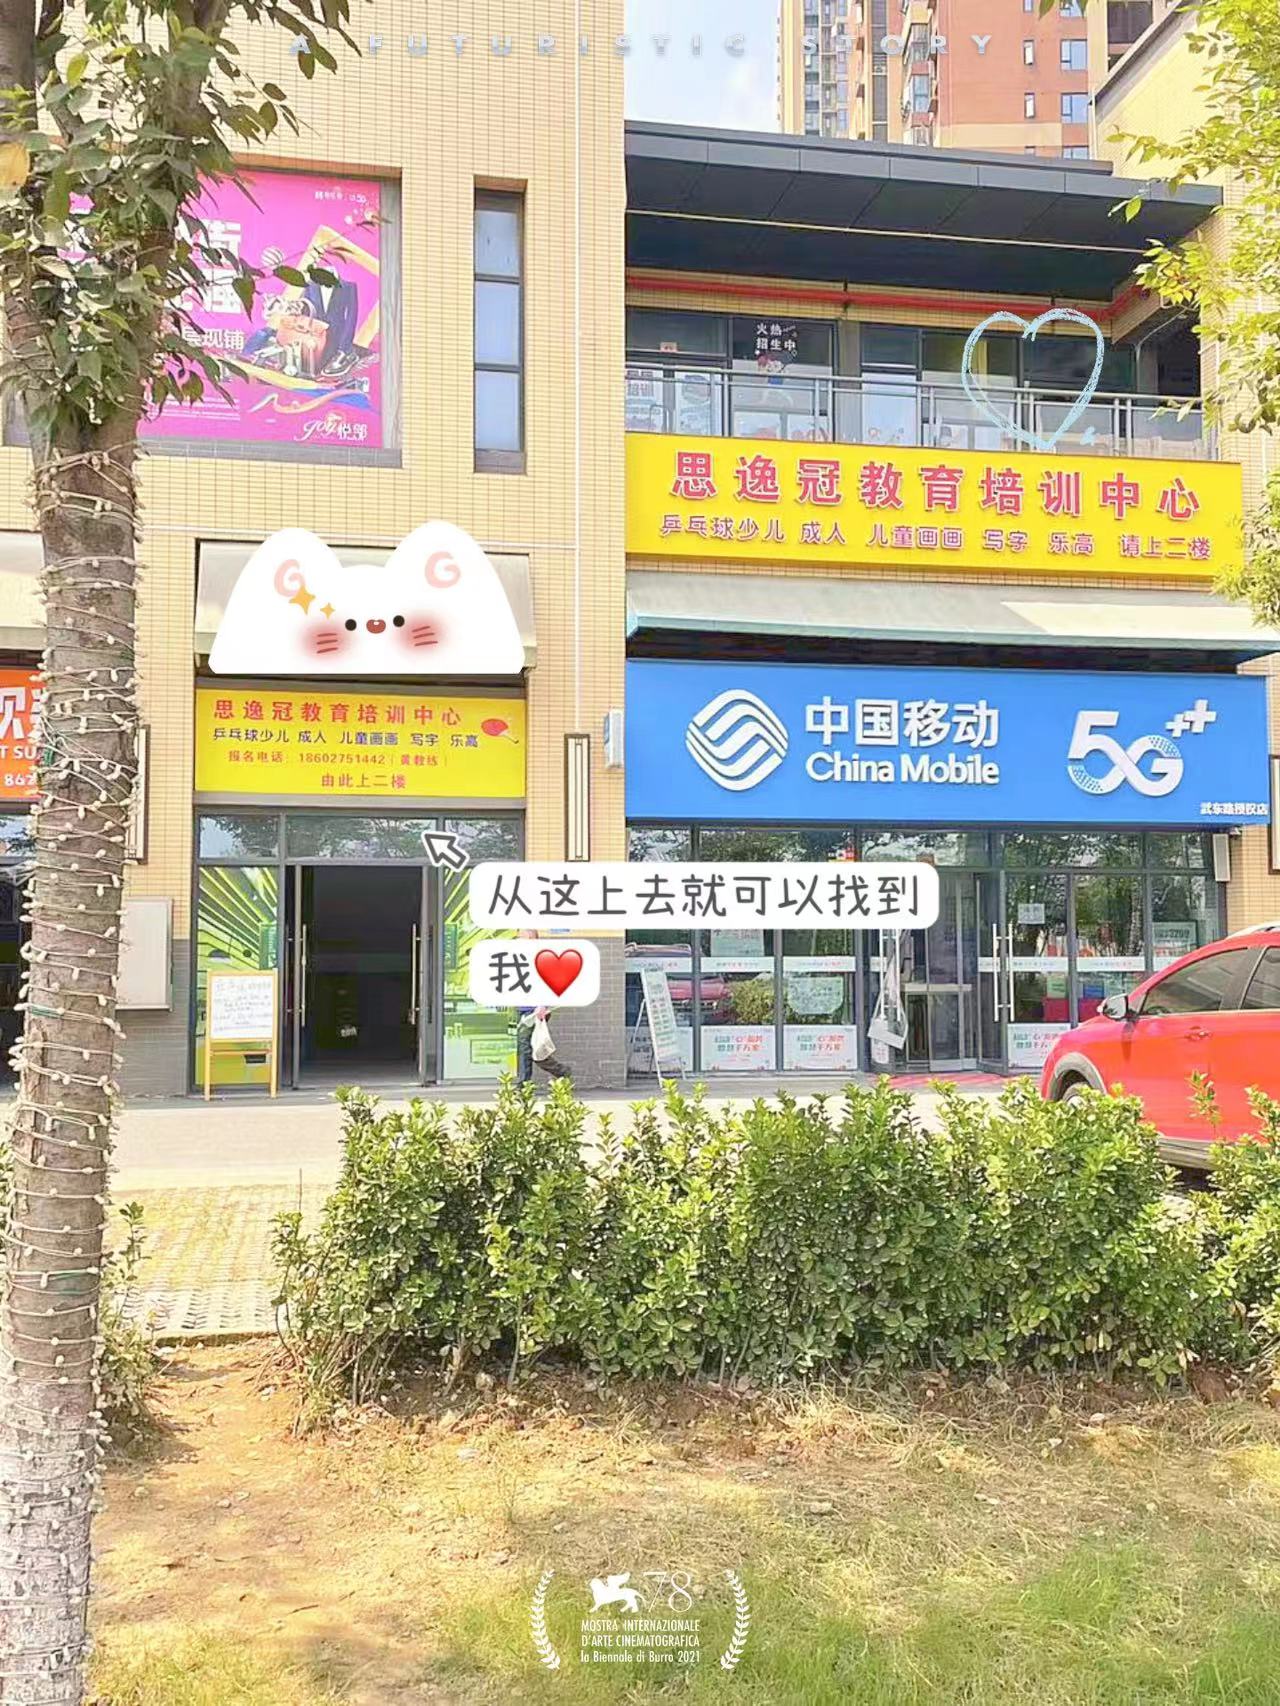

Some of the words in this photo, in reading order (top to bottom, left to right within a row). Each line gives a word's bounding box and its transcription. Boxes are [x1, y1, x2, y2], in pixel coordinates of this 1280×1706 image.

[756, 322, 782, 336] 火热
[756, 337, 796, 351] 招生中
[671, 450, 1200, 522] 思逸冠教育培训中心
[660, 514, 785, 544] 乒乓球少儿
[800, 521, 847, 545] 成人
[868, 523, 962, 550] 儿童画画
[982, 528, 1029, 552] 写字
[1048, 532, 1094, 556] 乐高
[1119, 533, 1212, 560] 请上二楼
[213, 699, 462, 725] 思逸冠教育培训中心
[805, 696, 1000, 748] 中国移动
[213, 727, 290, 744] 乒乓球少儿
[297, 730, 328, 744] 成人
[339, 730, 399, 746] 儿童画画
[410, 732, 439, 747] 写字
[450, 733, 480, 748] 乐高
[805, 751, 895, 783] China
[900, 752, 1000, 784] Mobile
[322, 773, 407, 790] 由此上二楼
